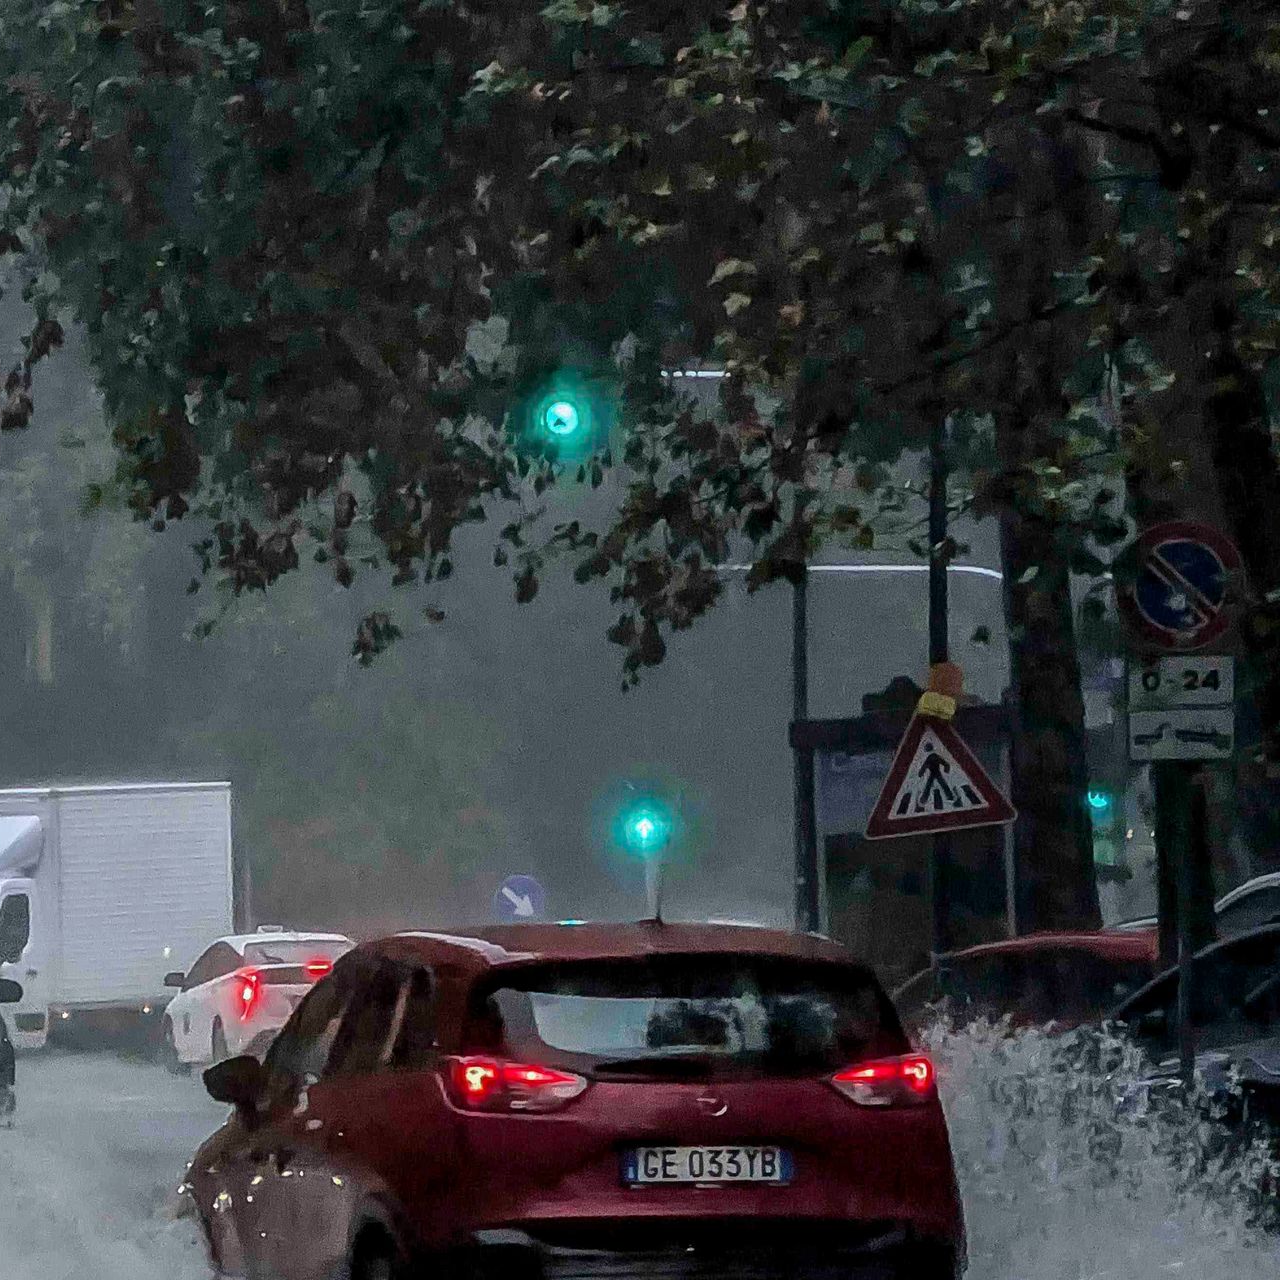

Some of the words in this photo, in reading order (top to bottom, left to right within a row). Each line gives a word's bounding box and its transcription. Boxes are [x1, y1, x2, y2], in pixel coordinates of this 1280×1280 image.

[1142, 670, 1161, 692] 0
[1183, 669, 1220, 692] 24
[643, 1149, 678, 1179] GE
[688, 1149, 777, 1178] 033YB
